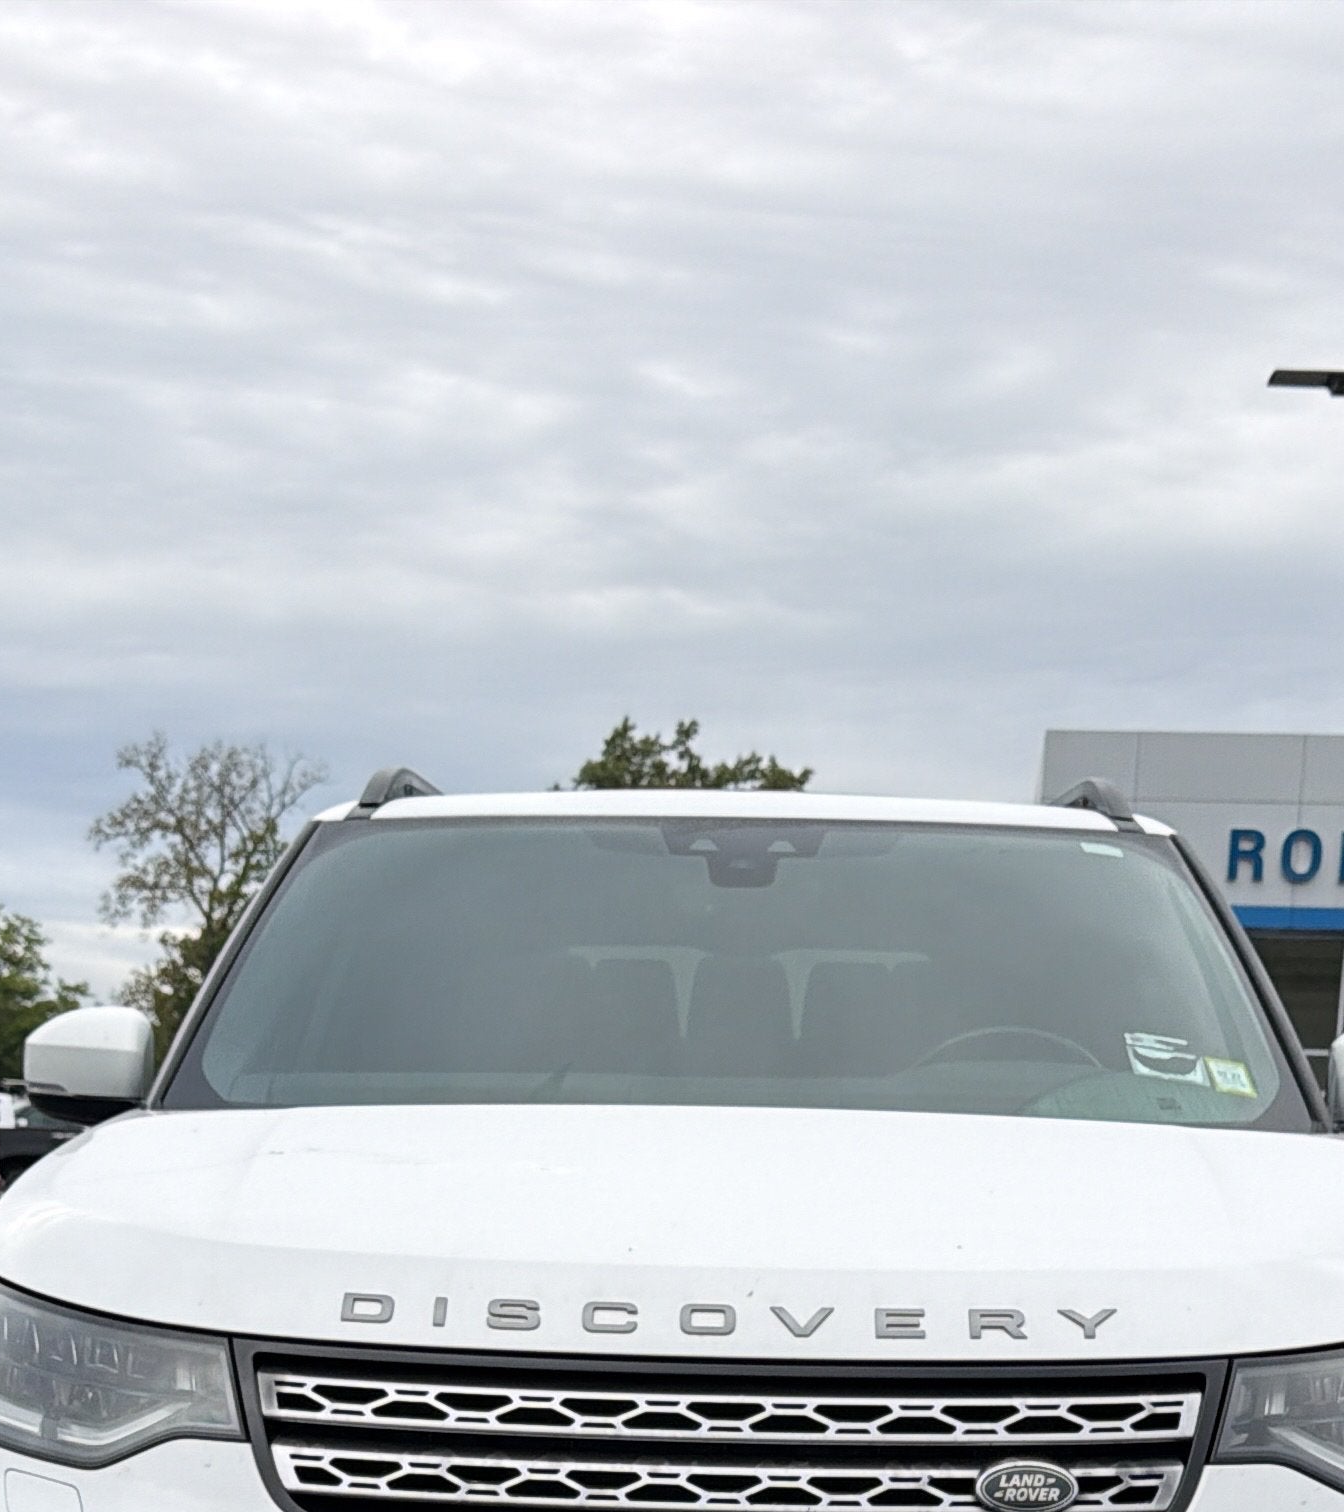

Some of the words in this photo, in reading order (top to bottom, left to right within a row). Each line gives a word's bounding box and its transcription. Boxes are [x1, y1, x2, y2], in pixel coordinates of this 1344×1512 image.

[340, 1292, 1118, 1341] DISCOVERY
[999, 1474, 1045, 1487] LAND
[1004, 1487, 1060, 1501] ROVER
